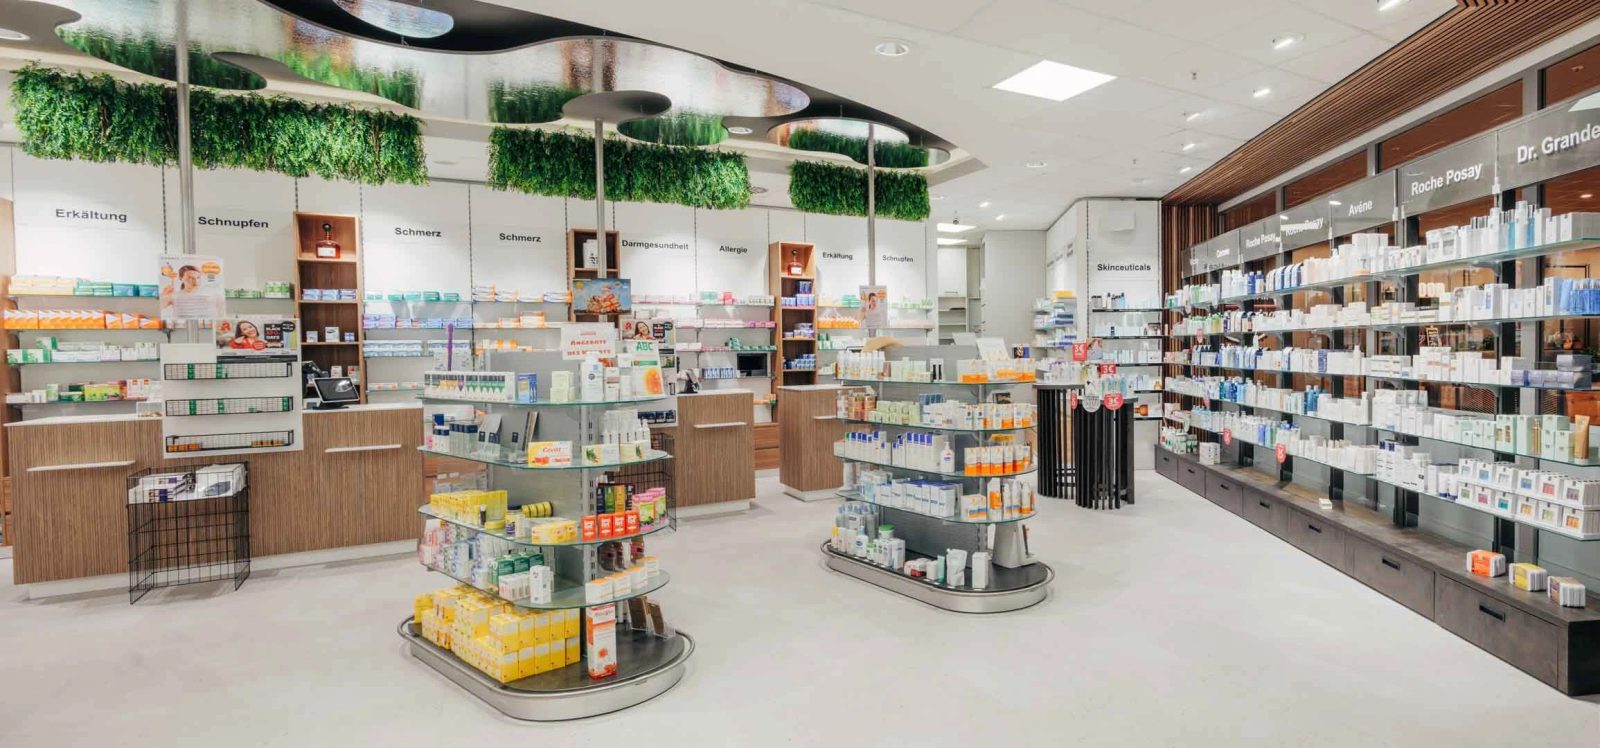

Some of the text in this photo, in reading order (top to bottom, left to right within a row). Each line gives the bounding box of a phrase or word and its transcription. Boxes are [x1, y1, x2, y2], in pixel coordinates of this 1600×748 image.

[1517, 145, 1538, 163] Dr.
[1411, 163, 1482, 196] Roche Posay
[55, 208, 128, 223] Erkältung
[198, 216, 269, 229] Schnupfen
[394, 227, 442, 238] Schmerz
[499, 232, 541, 243] Schmerz
[621, 239, 689, 251] Darmgesundheit
[719, 245, 748, 255] Allergie
[822, 251, 854, 261] Erkältung
[882, 254, 914, 263] Schnupfen
[1097, 263, 1151, 272] Skinceuticals
[635, 341, 654, 351] ABC
